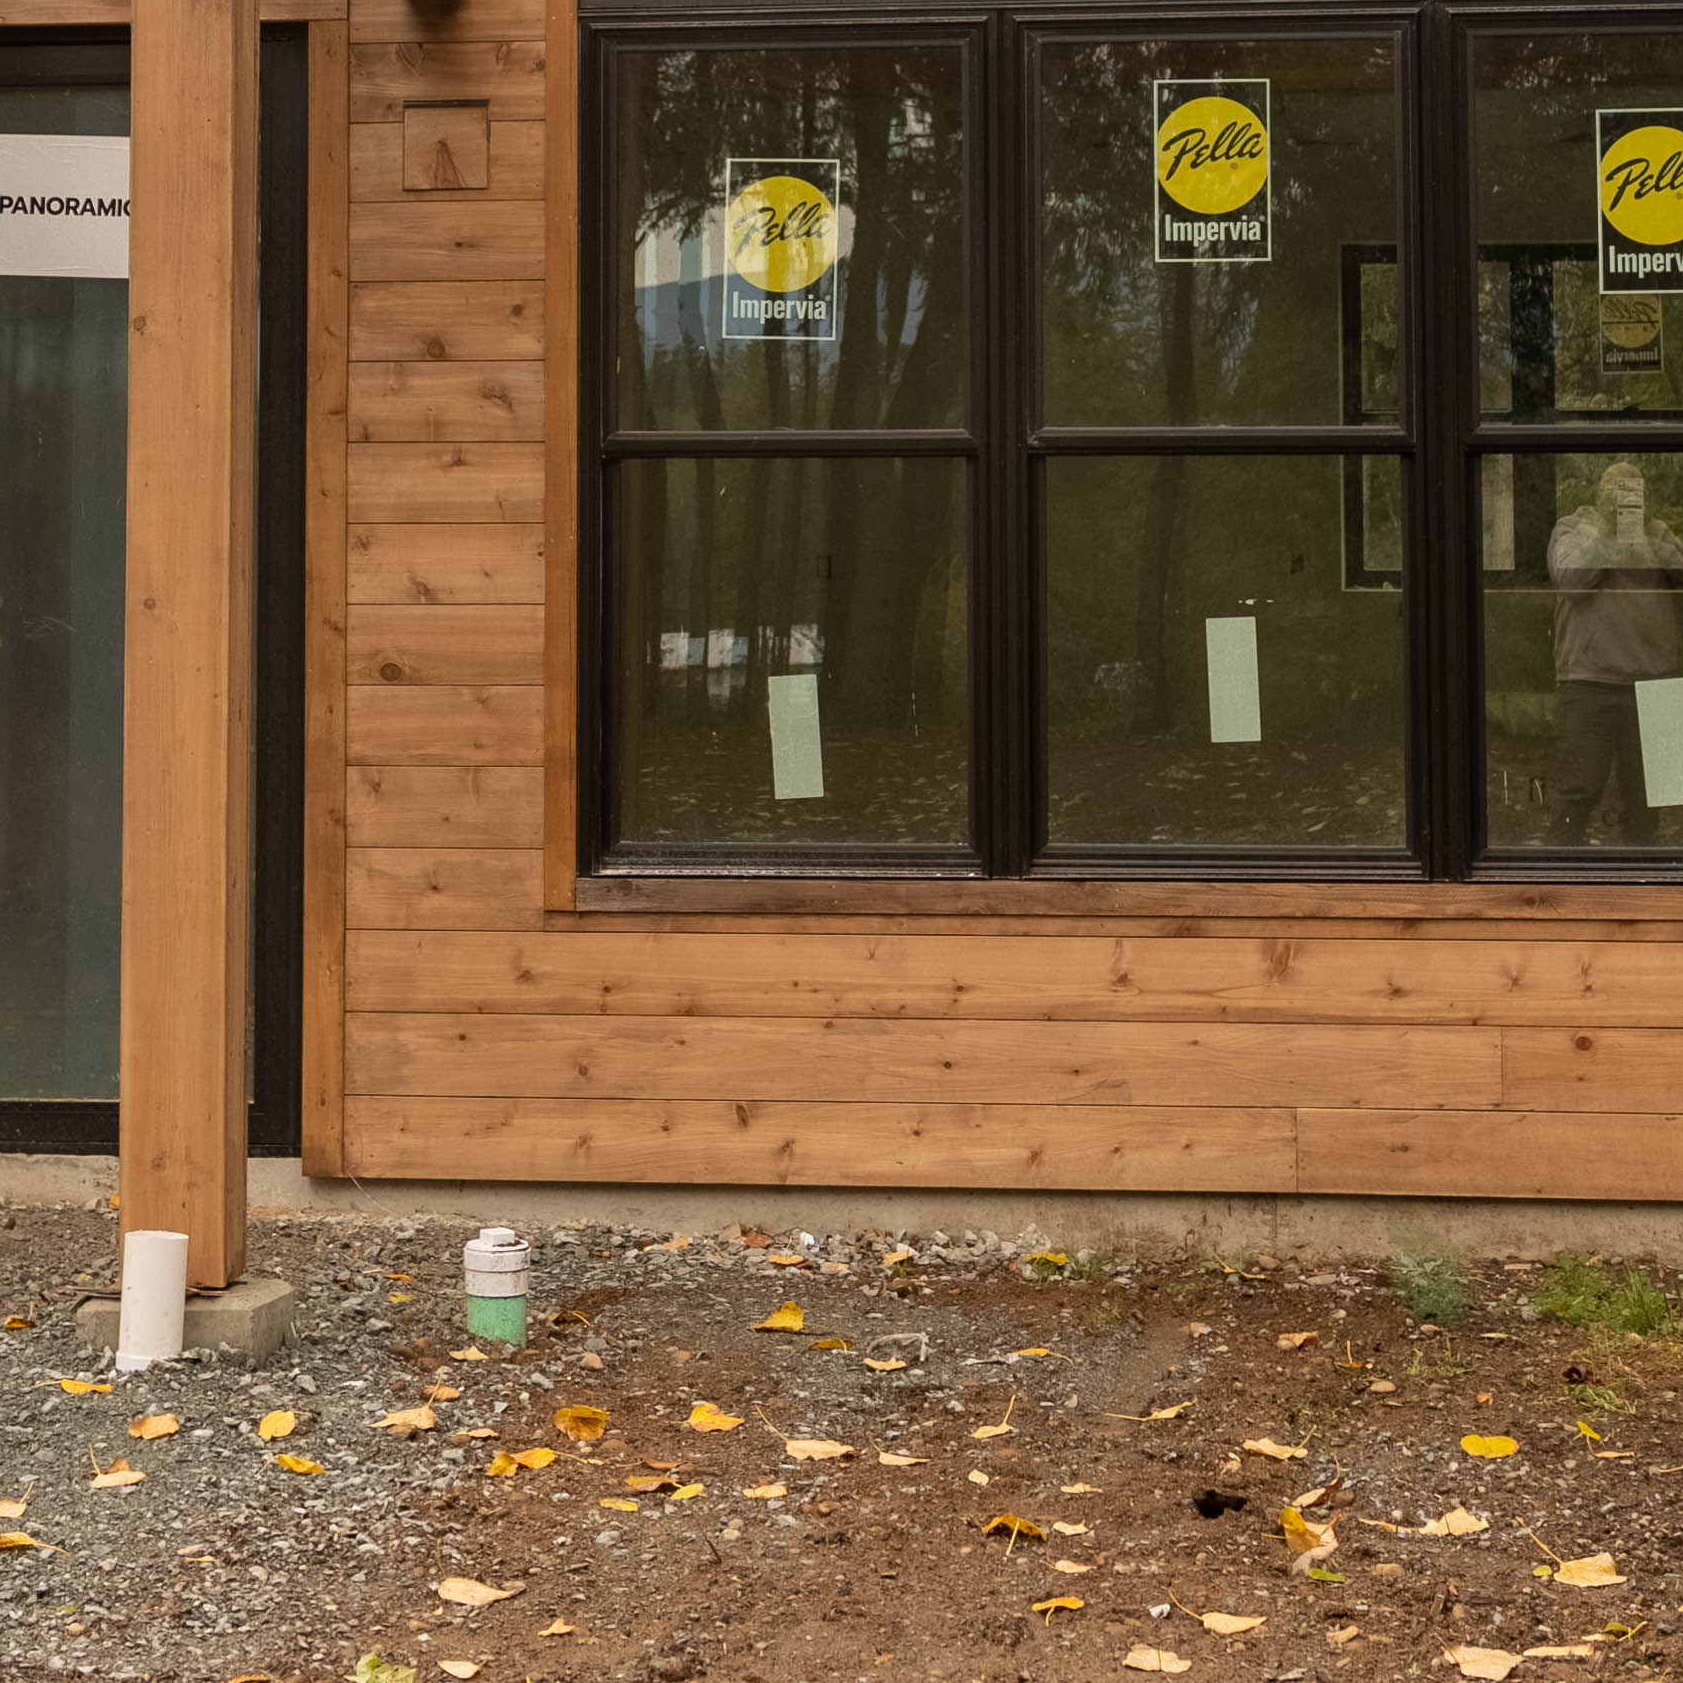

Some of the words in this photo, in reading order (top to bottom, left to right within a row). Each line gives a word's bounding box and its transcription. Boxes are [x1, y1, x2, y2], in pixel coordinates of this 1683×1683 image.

[1162, 121, 1263, 181] Pella
[732, 201, 834, 257] Pella
[1165, 214, 1261, 247] Impervia
[732, 291, 827, 325] Impervia
